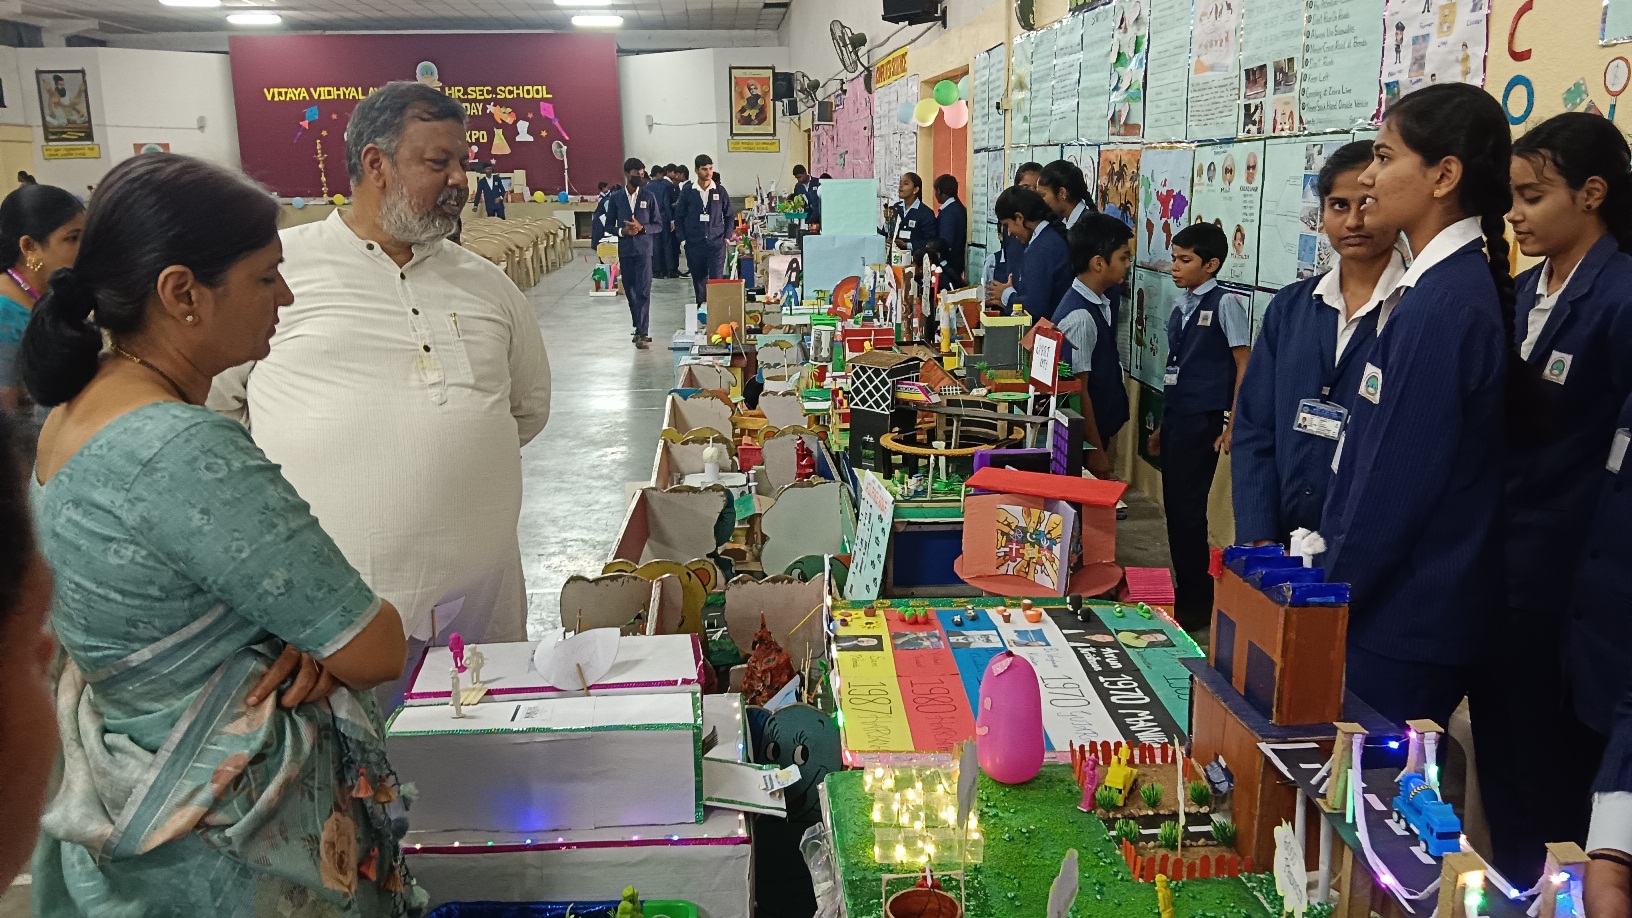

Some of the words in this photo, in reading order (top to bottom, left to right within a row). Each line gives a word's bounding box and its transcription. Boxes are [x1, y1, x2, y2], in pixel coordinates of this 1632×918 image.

[263, 87, 309, 101] VIJAYA
[465, 130, 487, 142] XPO
[1100, 647, 1122, 669] Arun
[848, 681, 892, 715] 1987
[910, 678, 957, 714] 1980
[1040, 674, 1090, 707] 1970
[1099, 673, 1150, 704] 1970
[1118, 709, 1169, 746] MANIP
